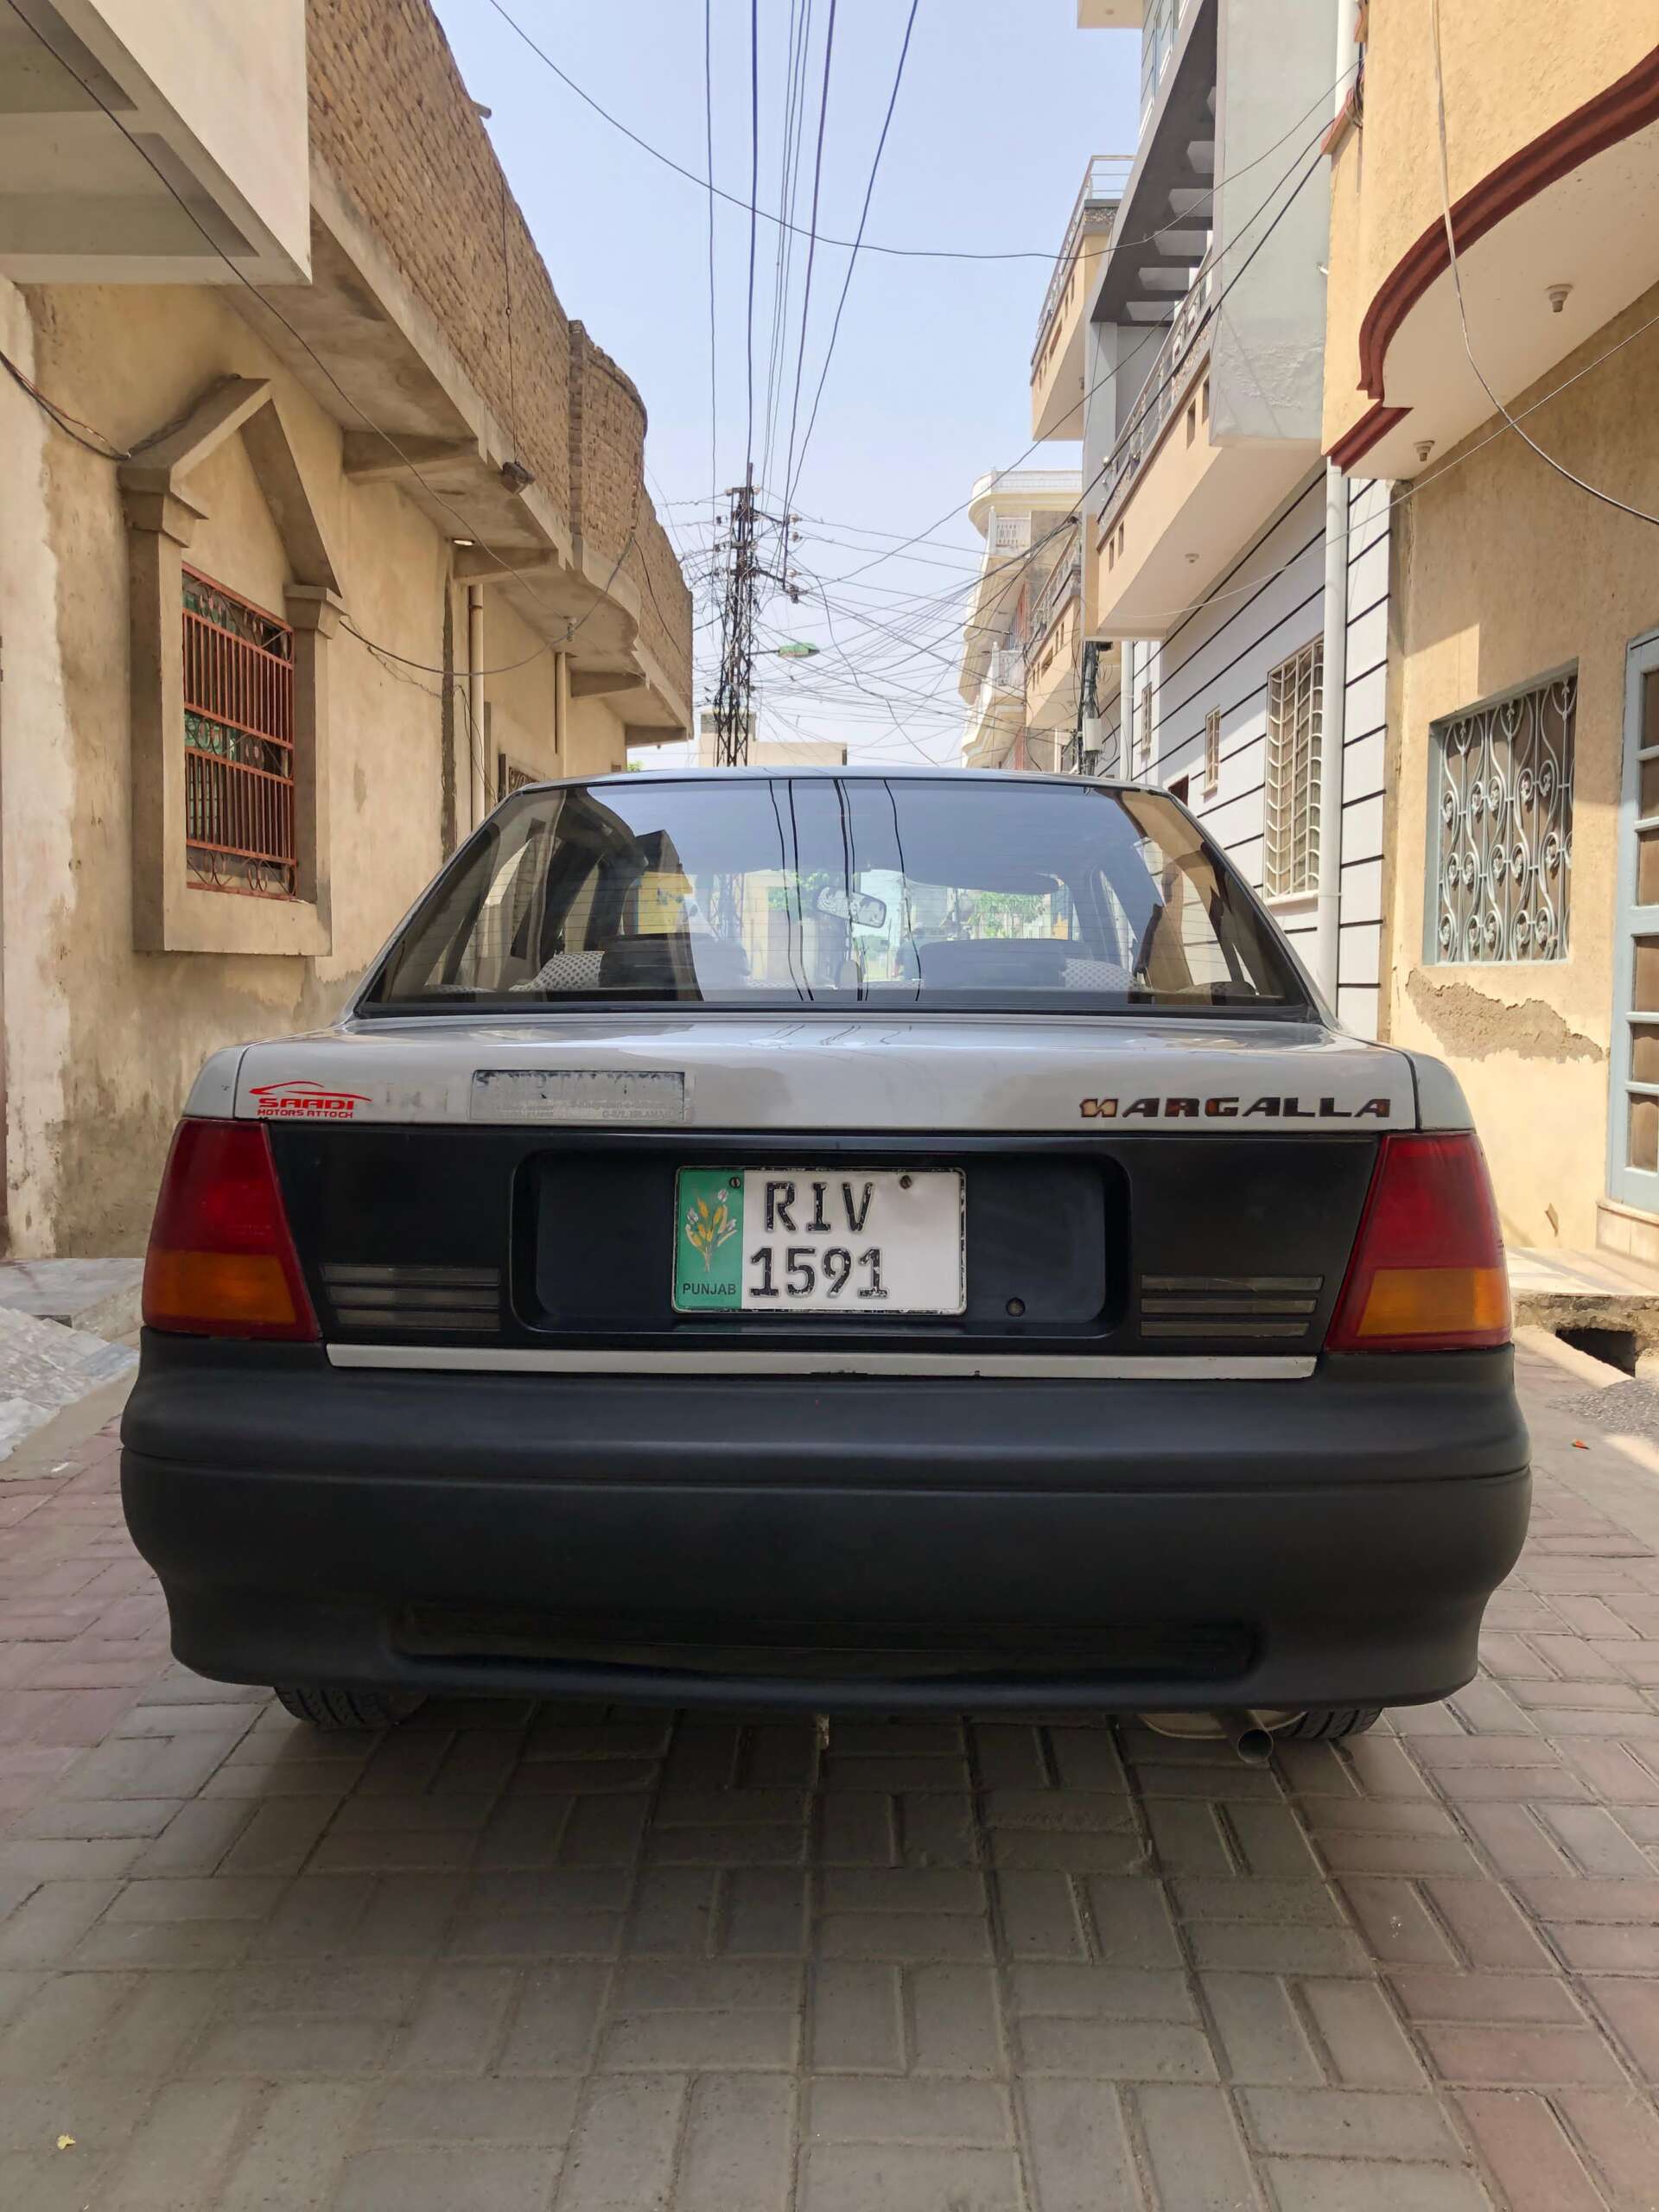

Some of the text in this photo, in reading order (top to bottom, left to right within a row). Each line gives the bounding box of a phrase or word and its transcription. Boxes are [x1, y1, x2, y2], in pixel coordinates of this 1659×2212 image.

[259, 1098, 355, 1110] SAADI
[1079, 1096, 1391, 1118] MARGALLA
[257, 1109, 304, 1117] MOTORS
[766, 1180, 874, 1232] RIV
[749, 1247, 889, 1298] 1591
[683, 1282, 737, 1295] PUNJAB
